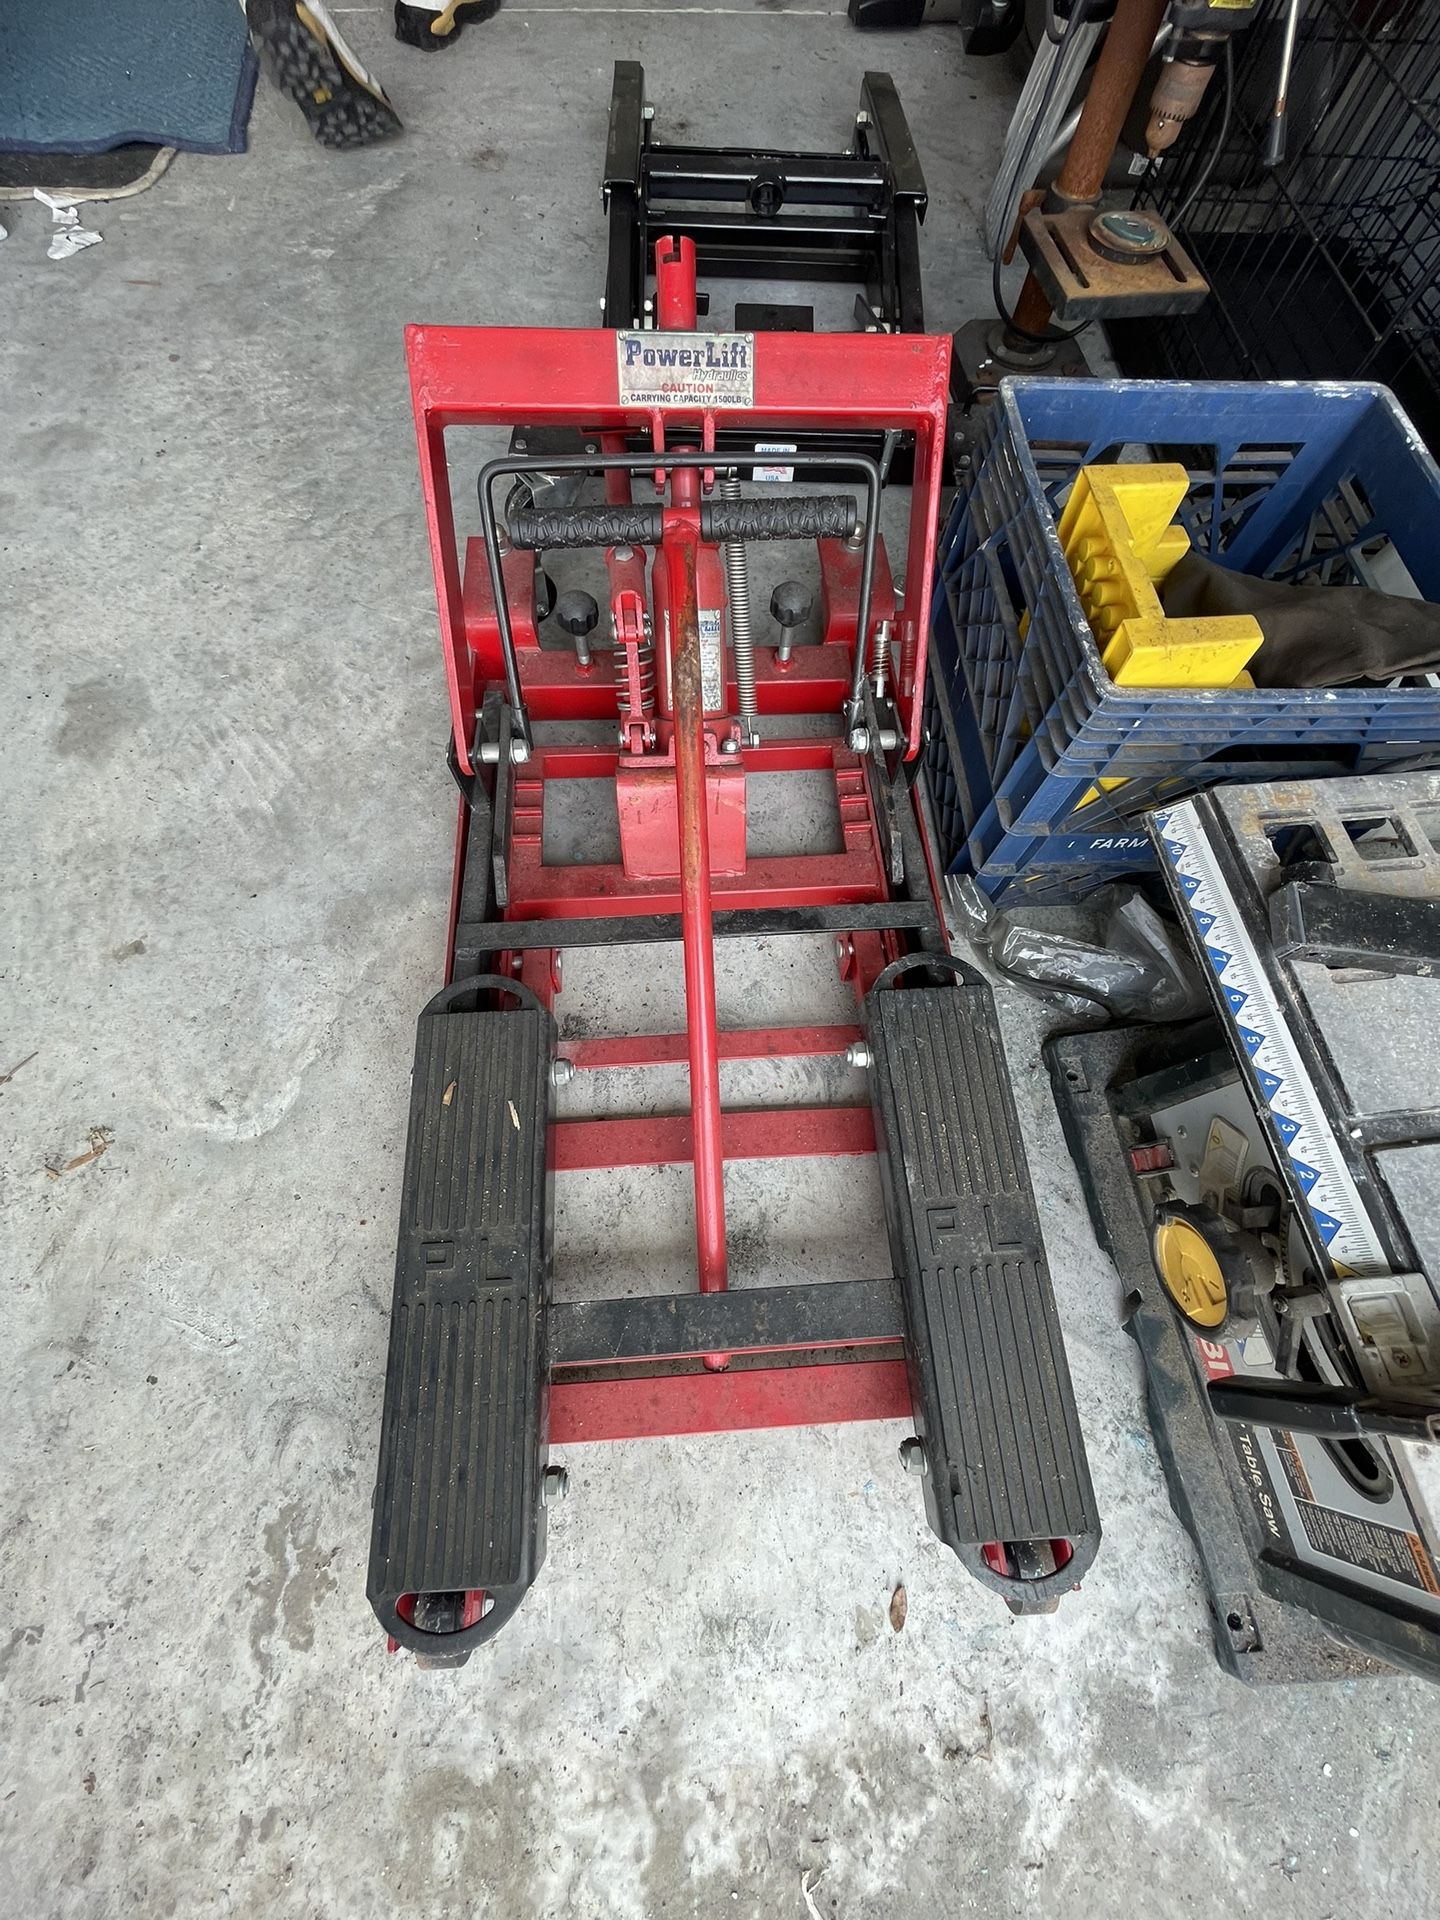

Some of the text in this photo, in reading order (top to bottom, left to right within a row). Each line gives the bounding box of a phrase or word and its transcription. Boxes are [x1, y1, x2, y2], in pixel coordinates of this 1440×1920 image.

[625, 340, 747, 368] PowerLift
[692, 368, 748, 382] Hydraulics
[662, 383, 714, 393] CAUTION
[630, 393, 671, 403] CARRYING
[673, 394, 711, 404] CAPACITY
[1089, 837, 1150, 849] FARM
[1170, 843, 1184, 855] 10
[1185, 880, 1198, 890] 9
[1199, 916, 1212, 926] 8
[1214, 954, 1228, 963] 7
[1230, 994, 1244, 1004] 6
[1246, 1035, 1260, 1045] 5
[1264, 1077, 1278, 1087] 4
[1281, 1122, 1296, 1133] 3
[1300, 1170, 1315, 1181] 2
[1320, 1220, 1336, 1229] 1
[1239, 1433, 1281, 1539] Table Saw
